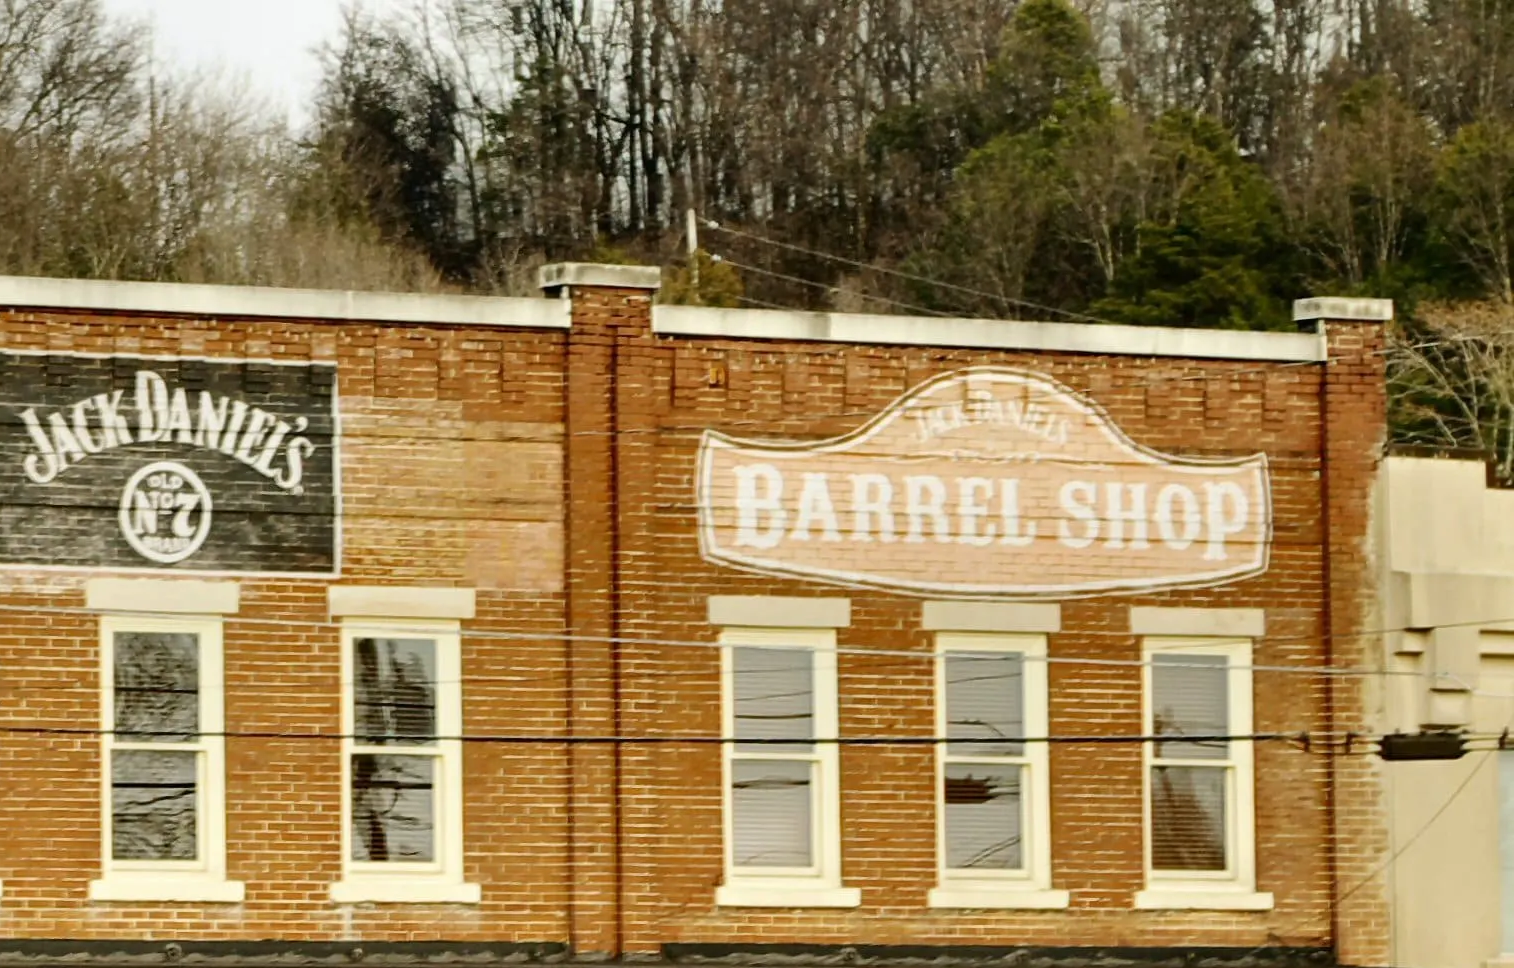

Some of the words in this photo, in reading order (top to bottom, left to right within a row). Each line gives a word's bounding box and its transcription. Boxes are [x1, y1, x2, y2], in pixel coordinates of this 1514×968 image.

[20, 389, 134, 484] JACK
[135, 370, 315, 491] DANIEL'S
[732, 463, 1037, 550] BARREL
[1056, 480, 1250, 560] SHOP
